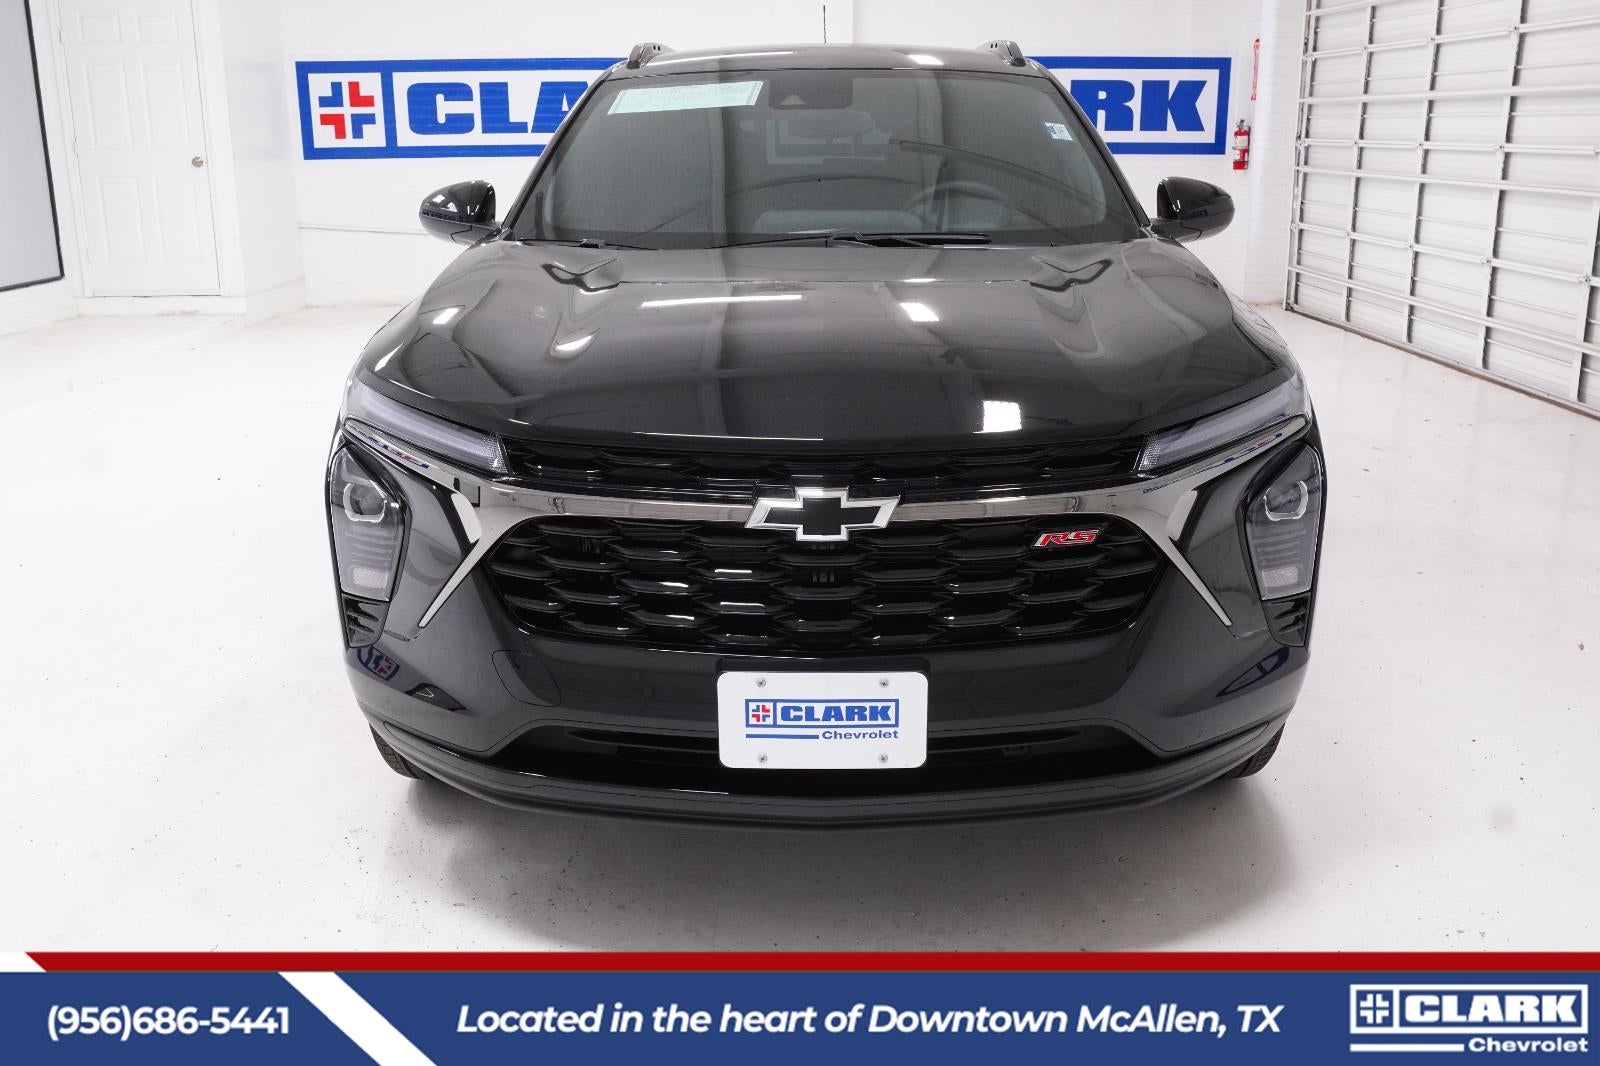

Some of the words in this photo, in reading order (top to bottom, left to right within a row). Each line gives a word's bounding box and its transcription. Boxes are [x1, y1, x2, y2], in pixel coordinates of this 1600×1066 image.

[406, 81, 590, 136] CLA
[1033, 529, 1100, 547] RS
[780, 705, 892, 722] CLARK
[821, 730, 899, 740] Chevrolet
